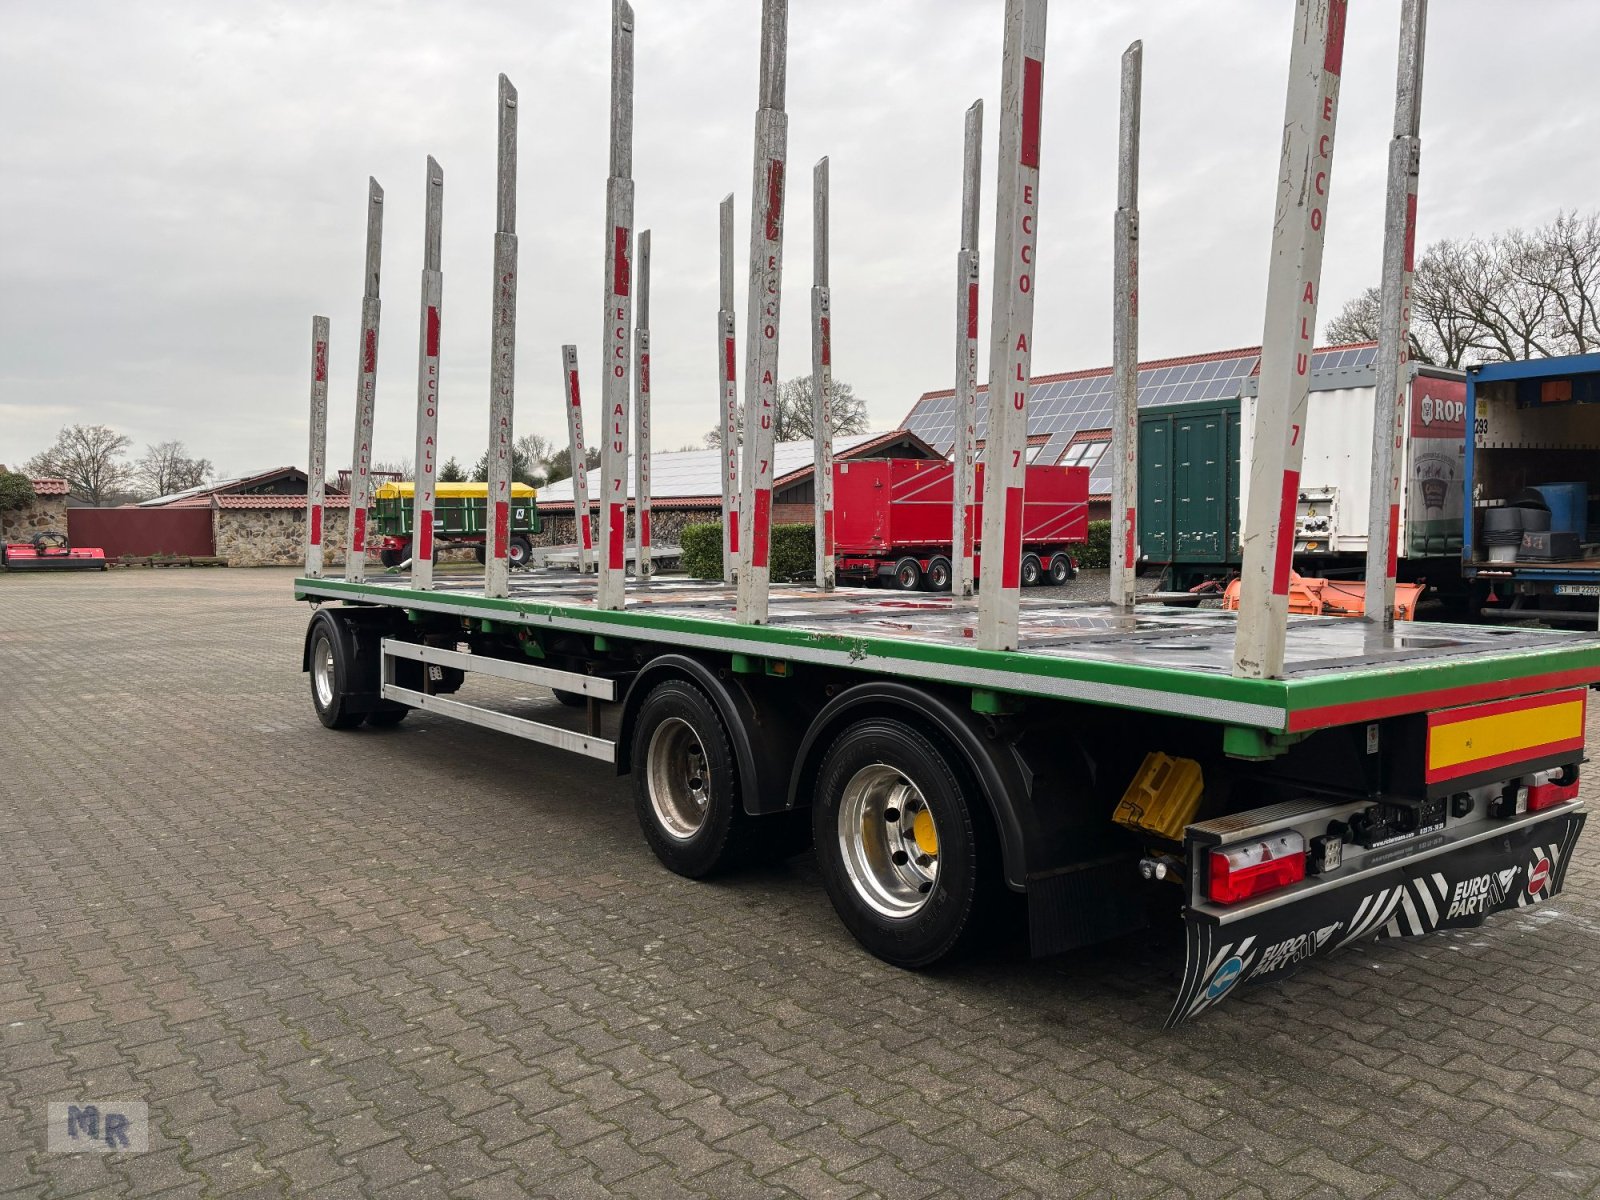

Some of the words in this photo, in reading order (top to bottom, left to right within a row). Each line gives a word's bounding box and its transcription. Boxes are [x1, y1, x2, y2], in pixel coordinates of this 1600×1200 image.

[1311, 97, 1332, 231] ECCO
[1019, 186, 1032, 293] ECCO
[764, 256, 777, 339] ECCO
[614, 308, 624, 378] ECCO
[1297, 281, 1314, 376] ALU
[1399, 286, 1409, 366] ECCO
[1014, 334, 1027, 411] ALU
[426, 366, 436, 417] ECCO
[761, 371, 772, 430] ALU
[614, 404, 623, 453] ALU
[1291, 424, 1300, 446] 7
[1395, 393, 1404, 450] ALU
[359, 443, 369, 476] ALU
[425, 436, 433, 473] ALU
[966, 424, 974, 465] ALU
[1012, 451, 1020, 468] 7
[500, 481, 506, 491] 7
[578, 462, 586, 489] ALU
[614, 480, 621, 491] 7
[760, 461, 768, 474] 7
[424, 492, 431, 500] 7
[966, 485, 972, 495] 7
[1453, 873, 1491, 901] EURO
[1446, 897, 1487, 921] PART
[1261, 934, 1306, 961] EURO
